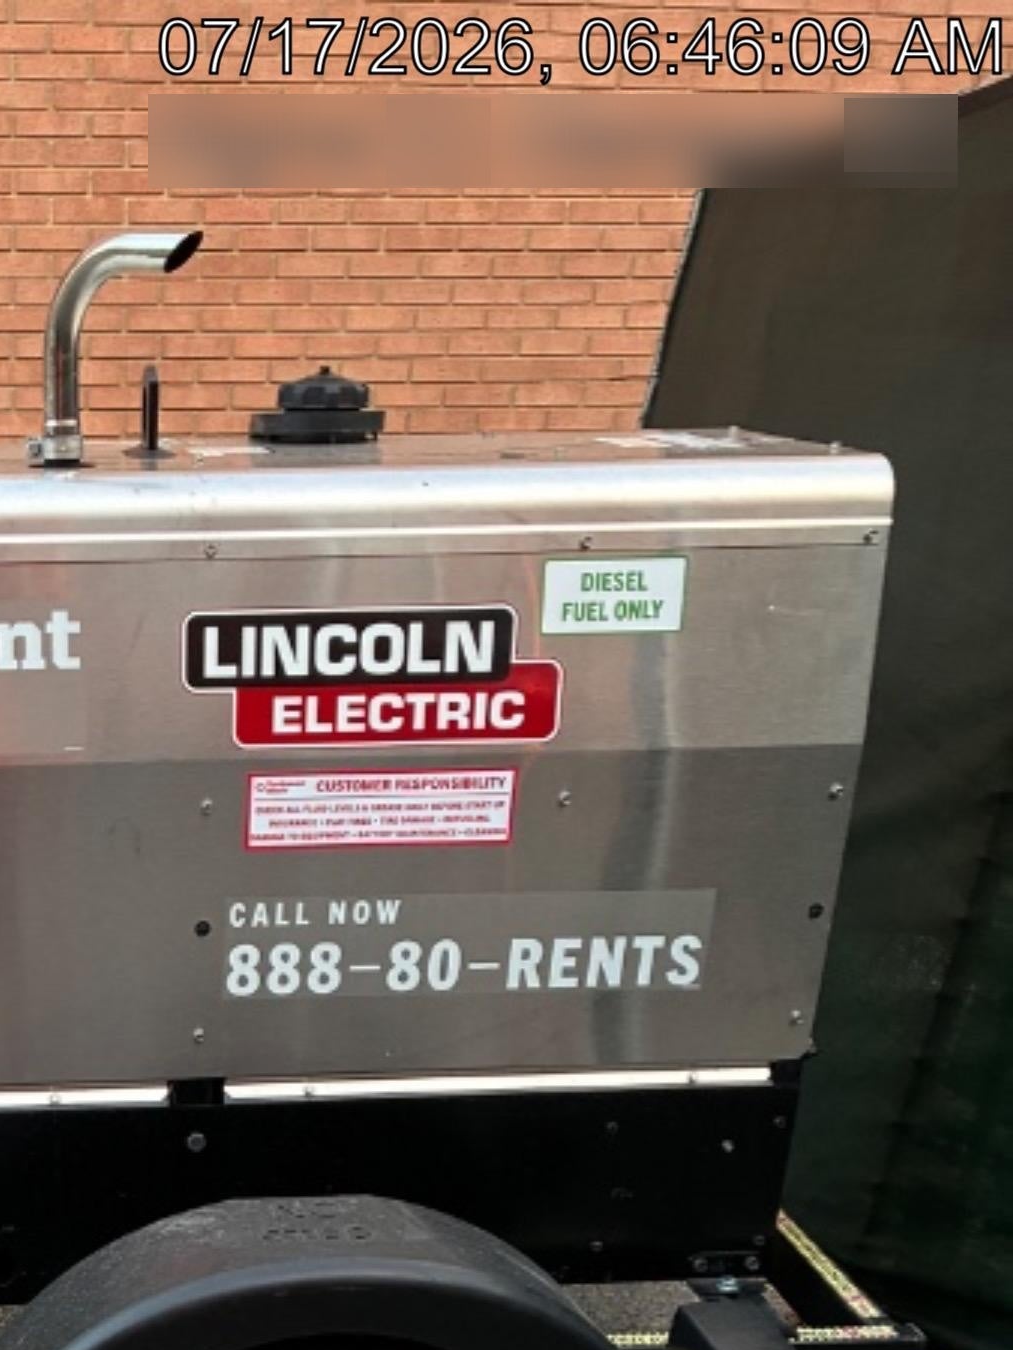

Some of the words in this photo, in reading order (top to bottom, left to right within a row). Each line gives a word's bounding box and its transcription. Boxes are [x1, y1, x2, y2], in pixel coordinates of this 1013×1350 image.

[580, 570, 648, 592] DIESEL
[561, 601, 608, 622] FUEL
[614, 600, 664, 621] ONLY
[203, 620, 496, 679] LINCOLN
[271, 689, 526, 734] ELECTRIC
[315, 779, 392, 793] CUSTOMER
[229, 902, 310, 928] CALL
[328, 899, 401, 925] NOW
